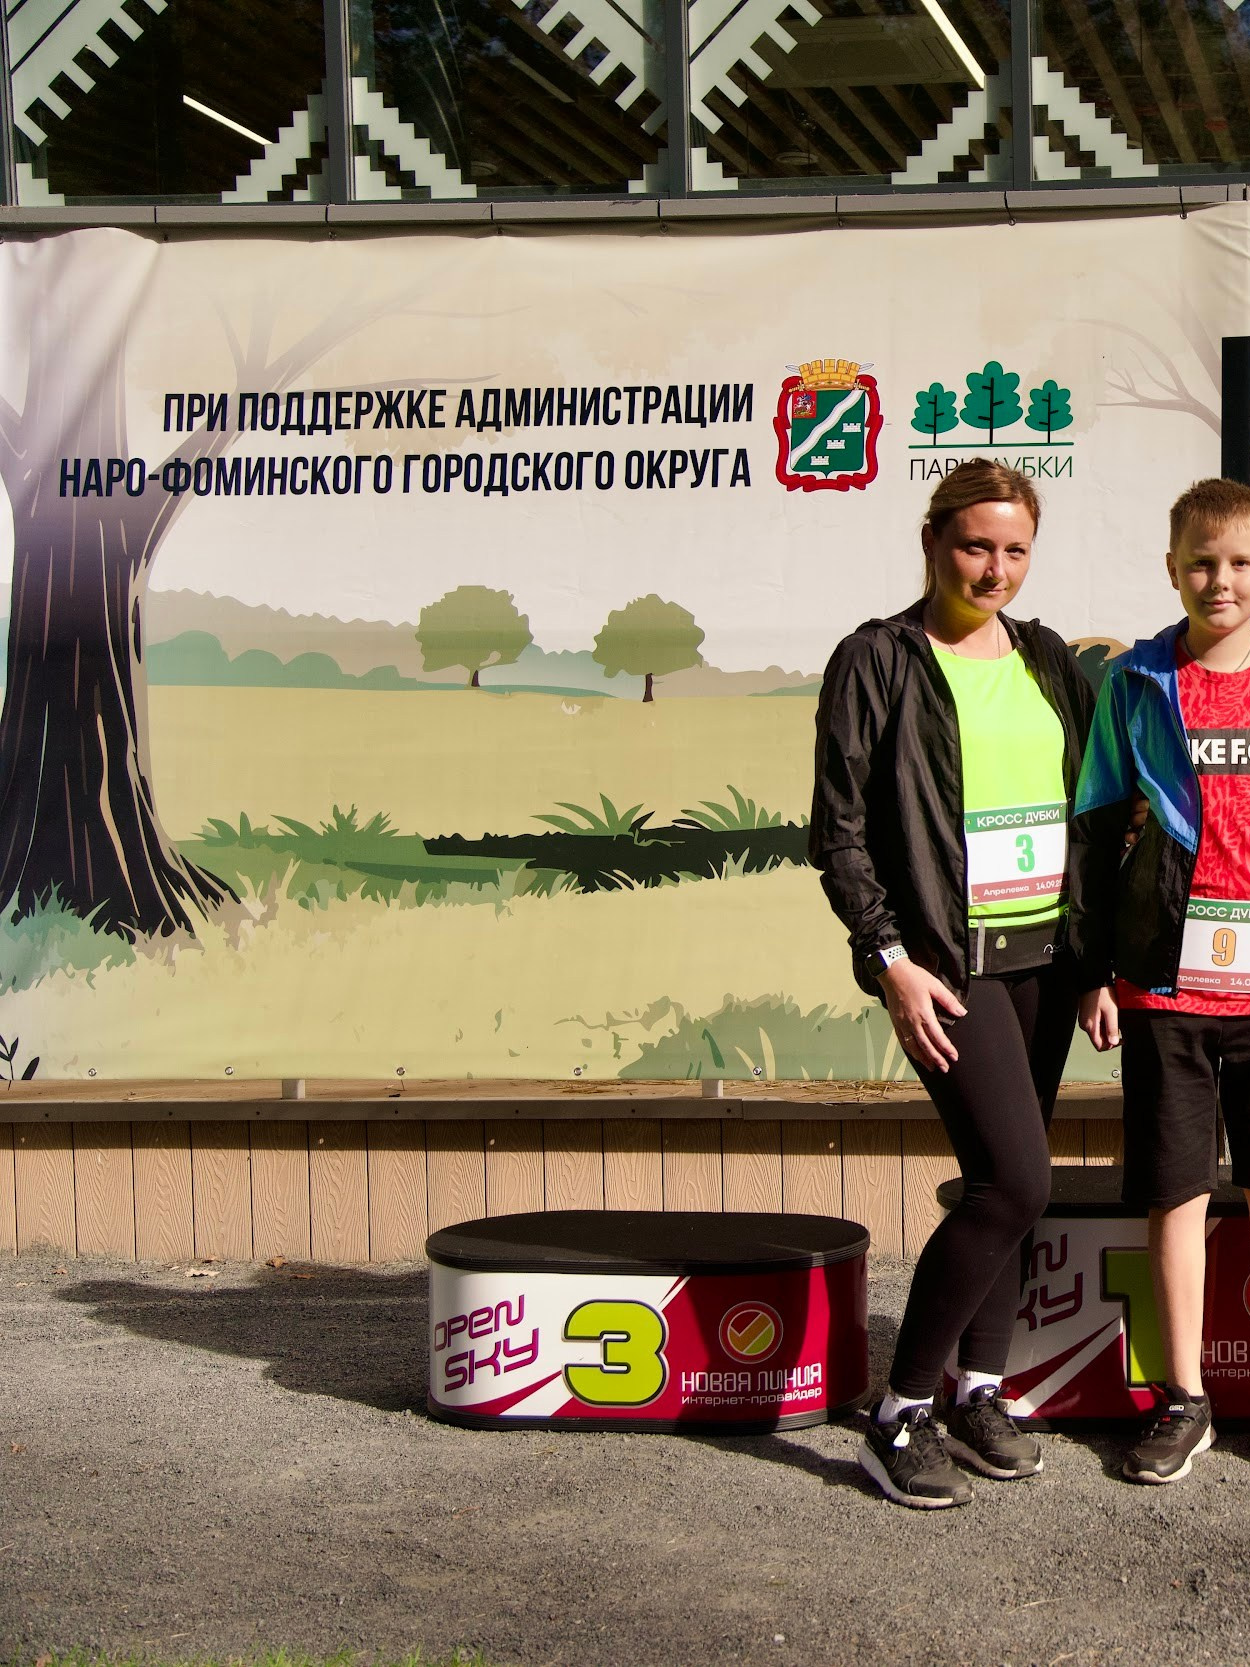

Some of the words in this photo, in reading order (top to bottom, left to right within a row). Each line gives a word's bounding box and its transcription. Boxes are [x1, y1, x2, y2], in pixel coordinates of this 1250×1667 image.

[162, 392, 228, 433] ПРИ
[237, 387, 447, 435] ПОДДЕРЖКЕ
[456, 382, 755, 434] АДМИНИСТРАЦИИ
[59, 453, 393, 498] НАРО-ФОМИНСКОГО
[402, 450, 617, 497] ГОРОДСКОГО
[625, 447, 752, 489] ОКРУГА
[910, 458, 974, 481] ПАР
[993, 456, 1073, 478] УБКИ
[1188, 738, 1226, 765] KE
[977, 813, 1022, 827] КРОСС
[1025, 809, 1060, 824] ДУБКИ
[1015, 834, 1035, 873] 3
[983, 885, 1030, 897] Апрелевка
[1187, 904, 1227, 918] РОСС
[1211, 927, 1237, 967] 9
[1177, 974, 1221, 985] прелевка
[444, 1327, 539, 1392] SKY
[563, 1299, 667, 1406] 3
[681, 1371, 751, 1392] НОВАЯ
[757, 1362, 822, 1391] ЛИНИЯ
[681, 1386, 822, 1407] интернет-провайдер
